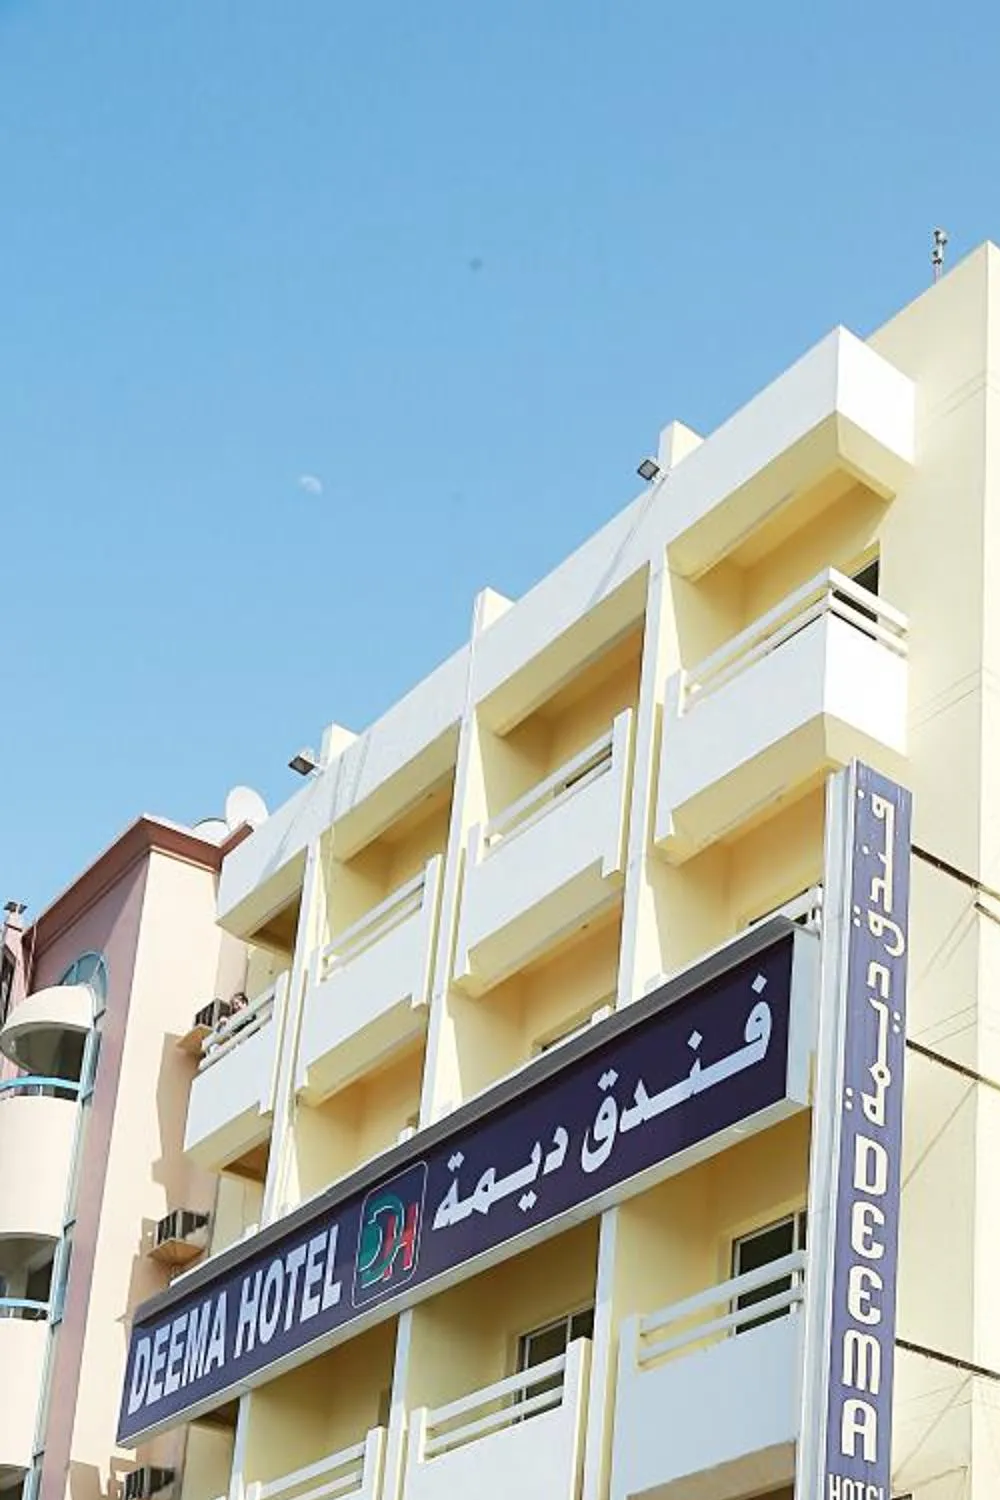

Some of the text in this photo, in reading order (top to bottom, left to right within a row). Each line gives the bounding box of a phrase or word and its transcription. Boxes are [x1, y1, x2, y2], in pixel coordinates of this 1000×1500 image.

[432, 972, 772, 1231] فندق ديمة
[128, 1224, 343, 1416] DEEMA HOTEL
